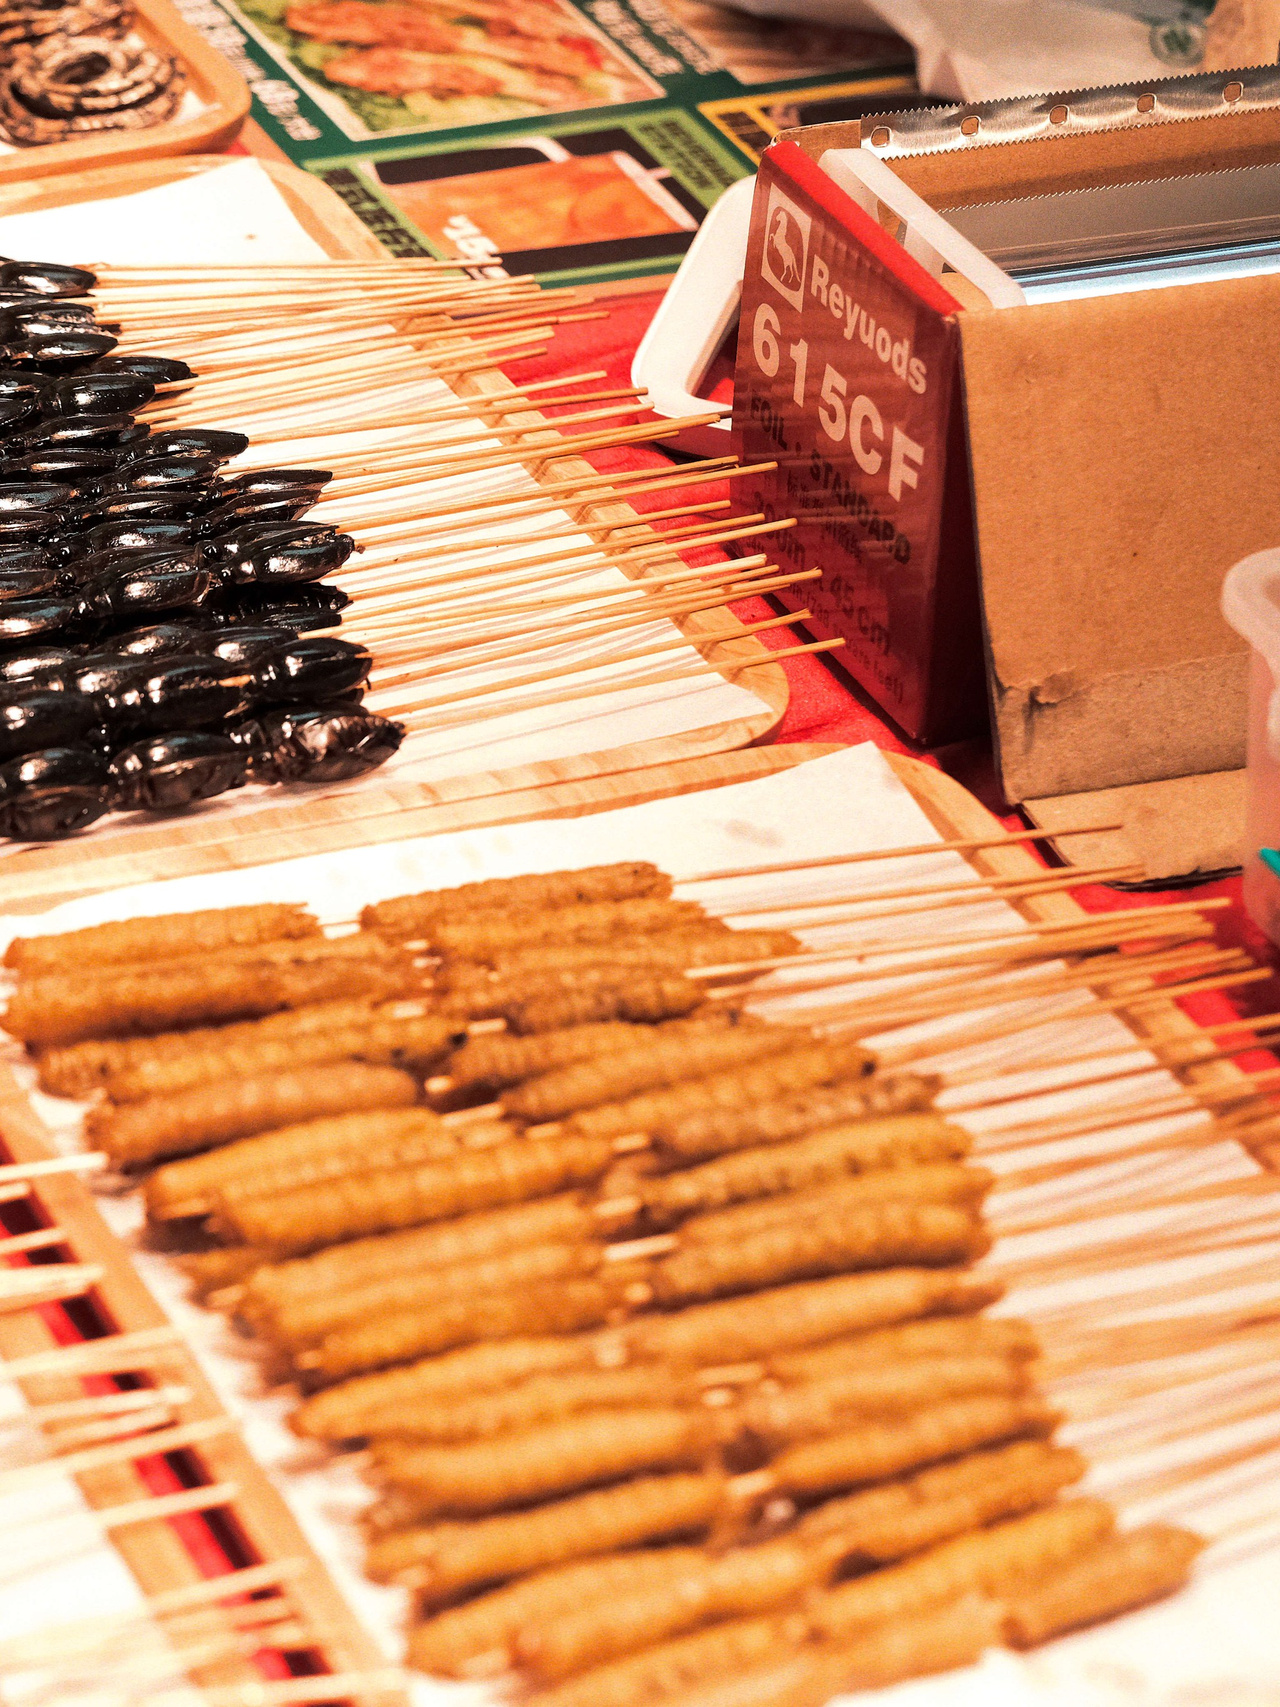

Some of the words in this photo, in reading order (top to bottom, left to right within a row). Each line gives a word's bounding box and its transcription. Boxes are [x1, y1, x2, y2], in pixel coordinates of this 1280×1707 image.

[810, 254, 927, 394] Reyuods
[751, 390, 788, 451] FOIL
[753, 302, 925, 502] 615CF
